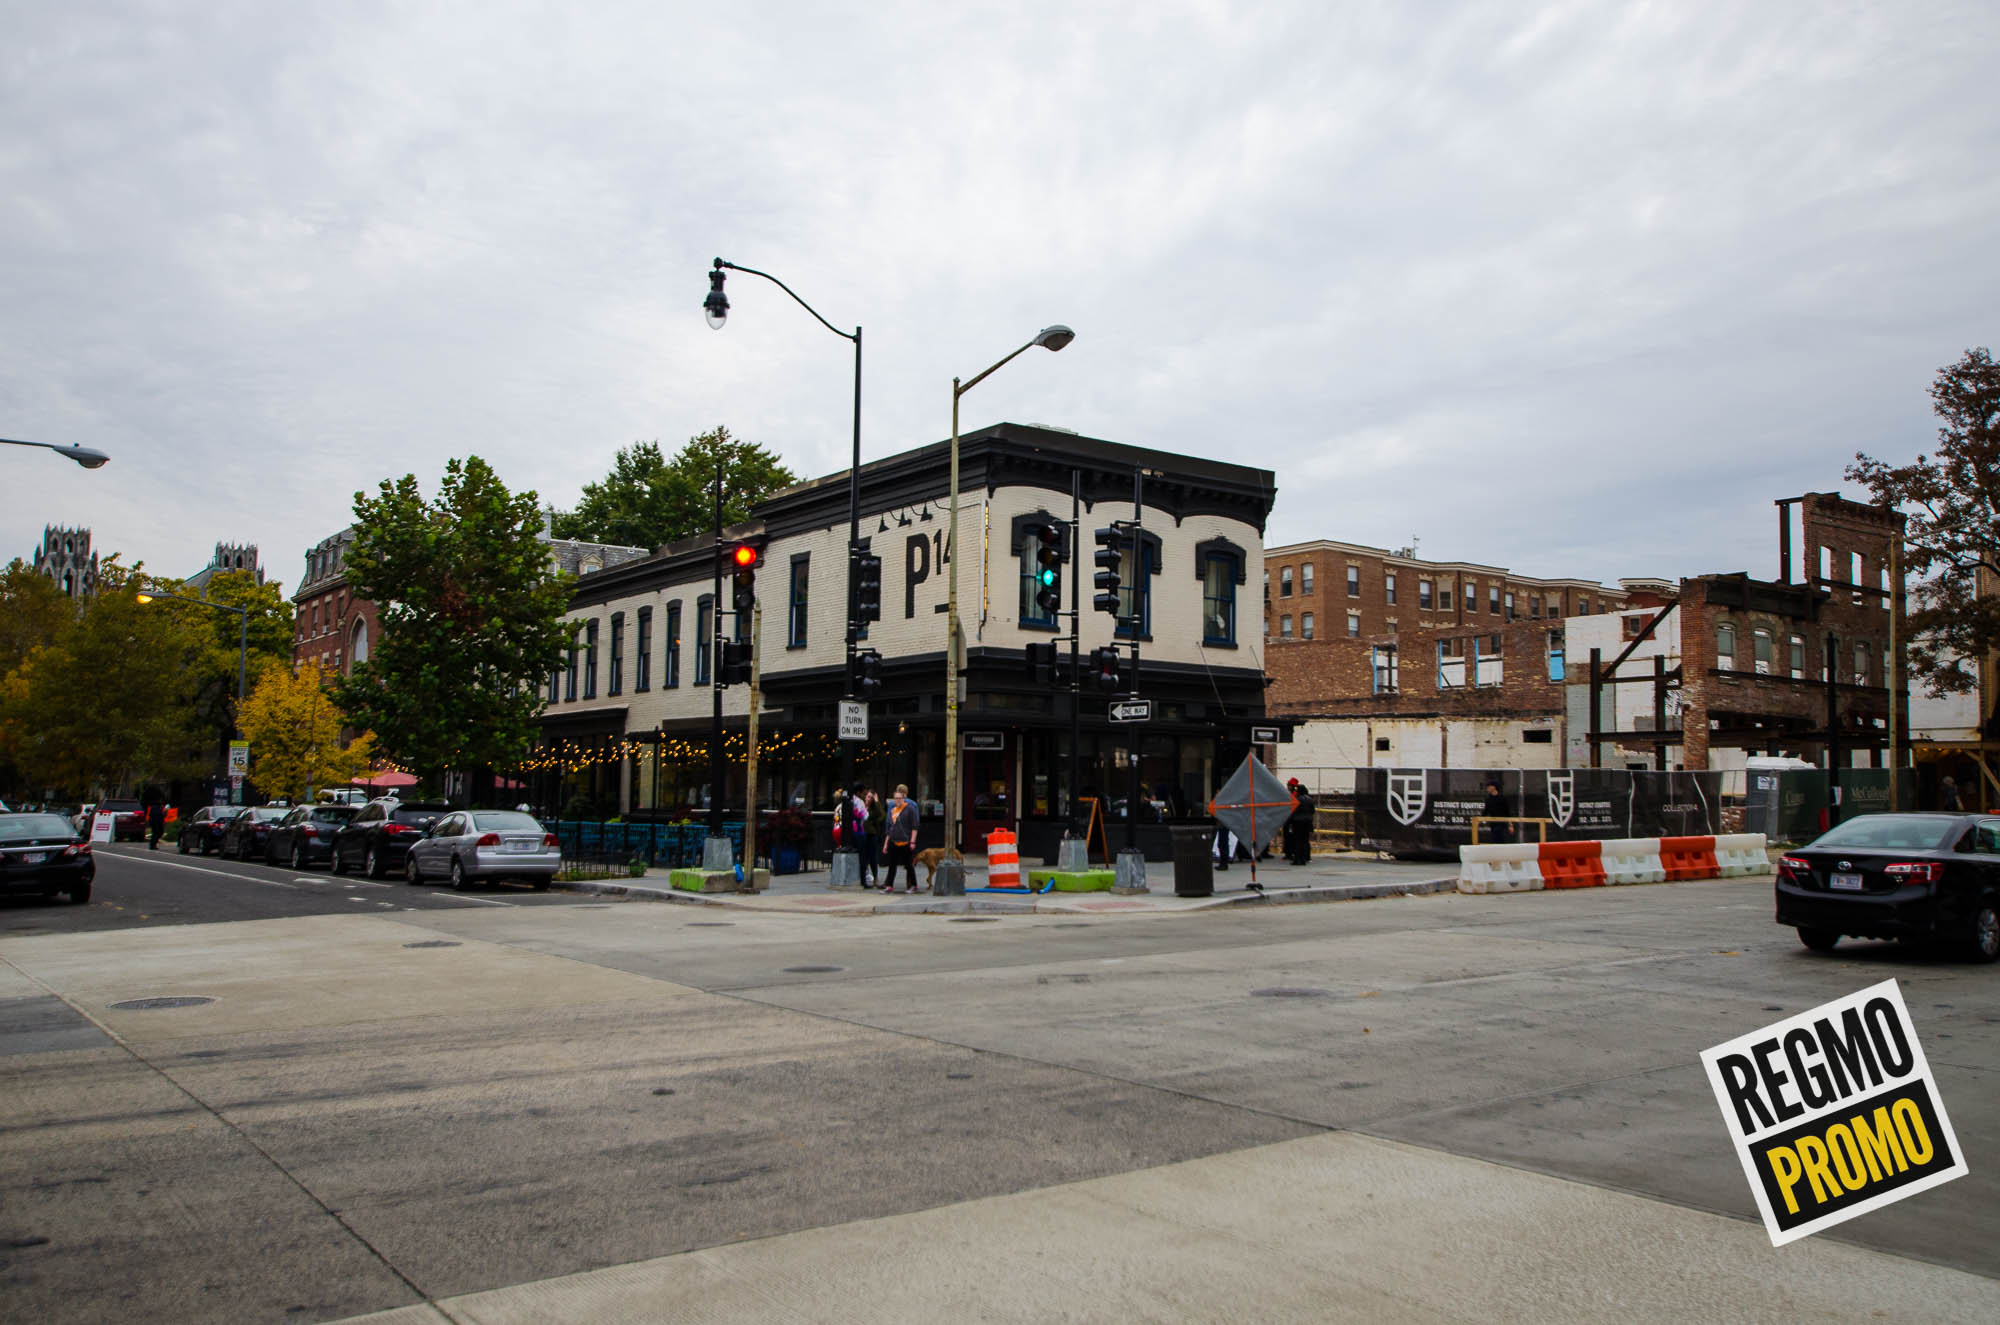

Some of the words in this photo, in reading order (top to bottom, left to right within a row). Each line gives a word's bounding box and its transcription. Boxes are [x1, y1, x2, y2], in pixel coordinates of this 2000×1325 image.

[848, 706, 860, 714] NO
[1121, 707, 1132, 715] ONE
[845, 716, 863, 724] TURN
[842, 727, 851, 735] ON
[853, 727, 866, 735] RED
[233, 757, 245, 765] 15
